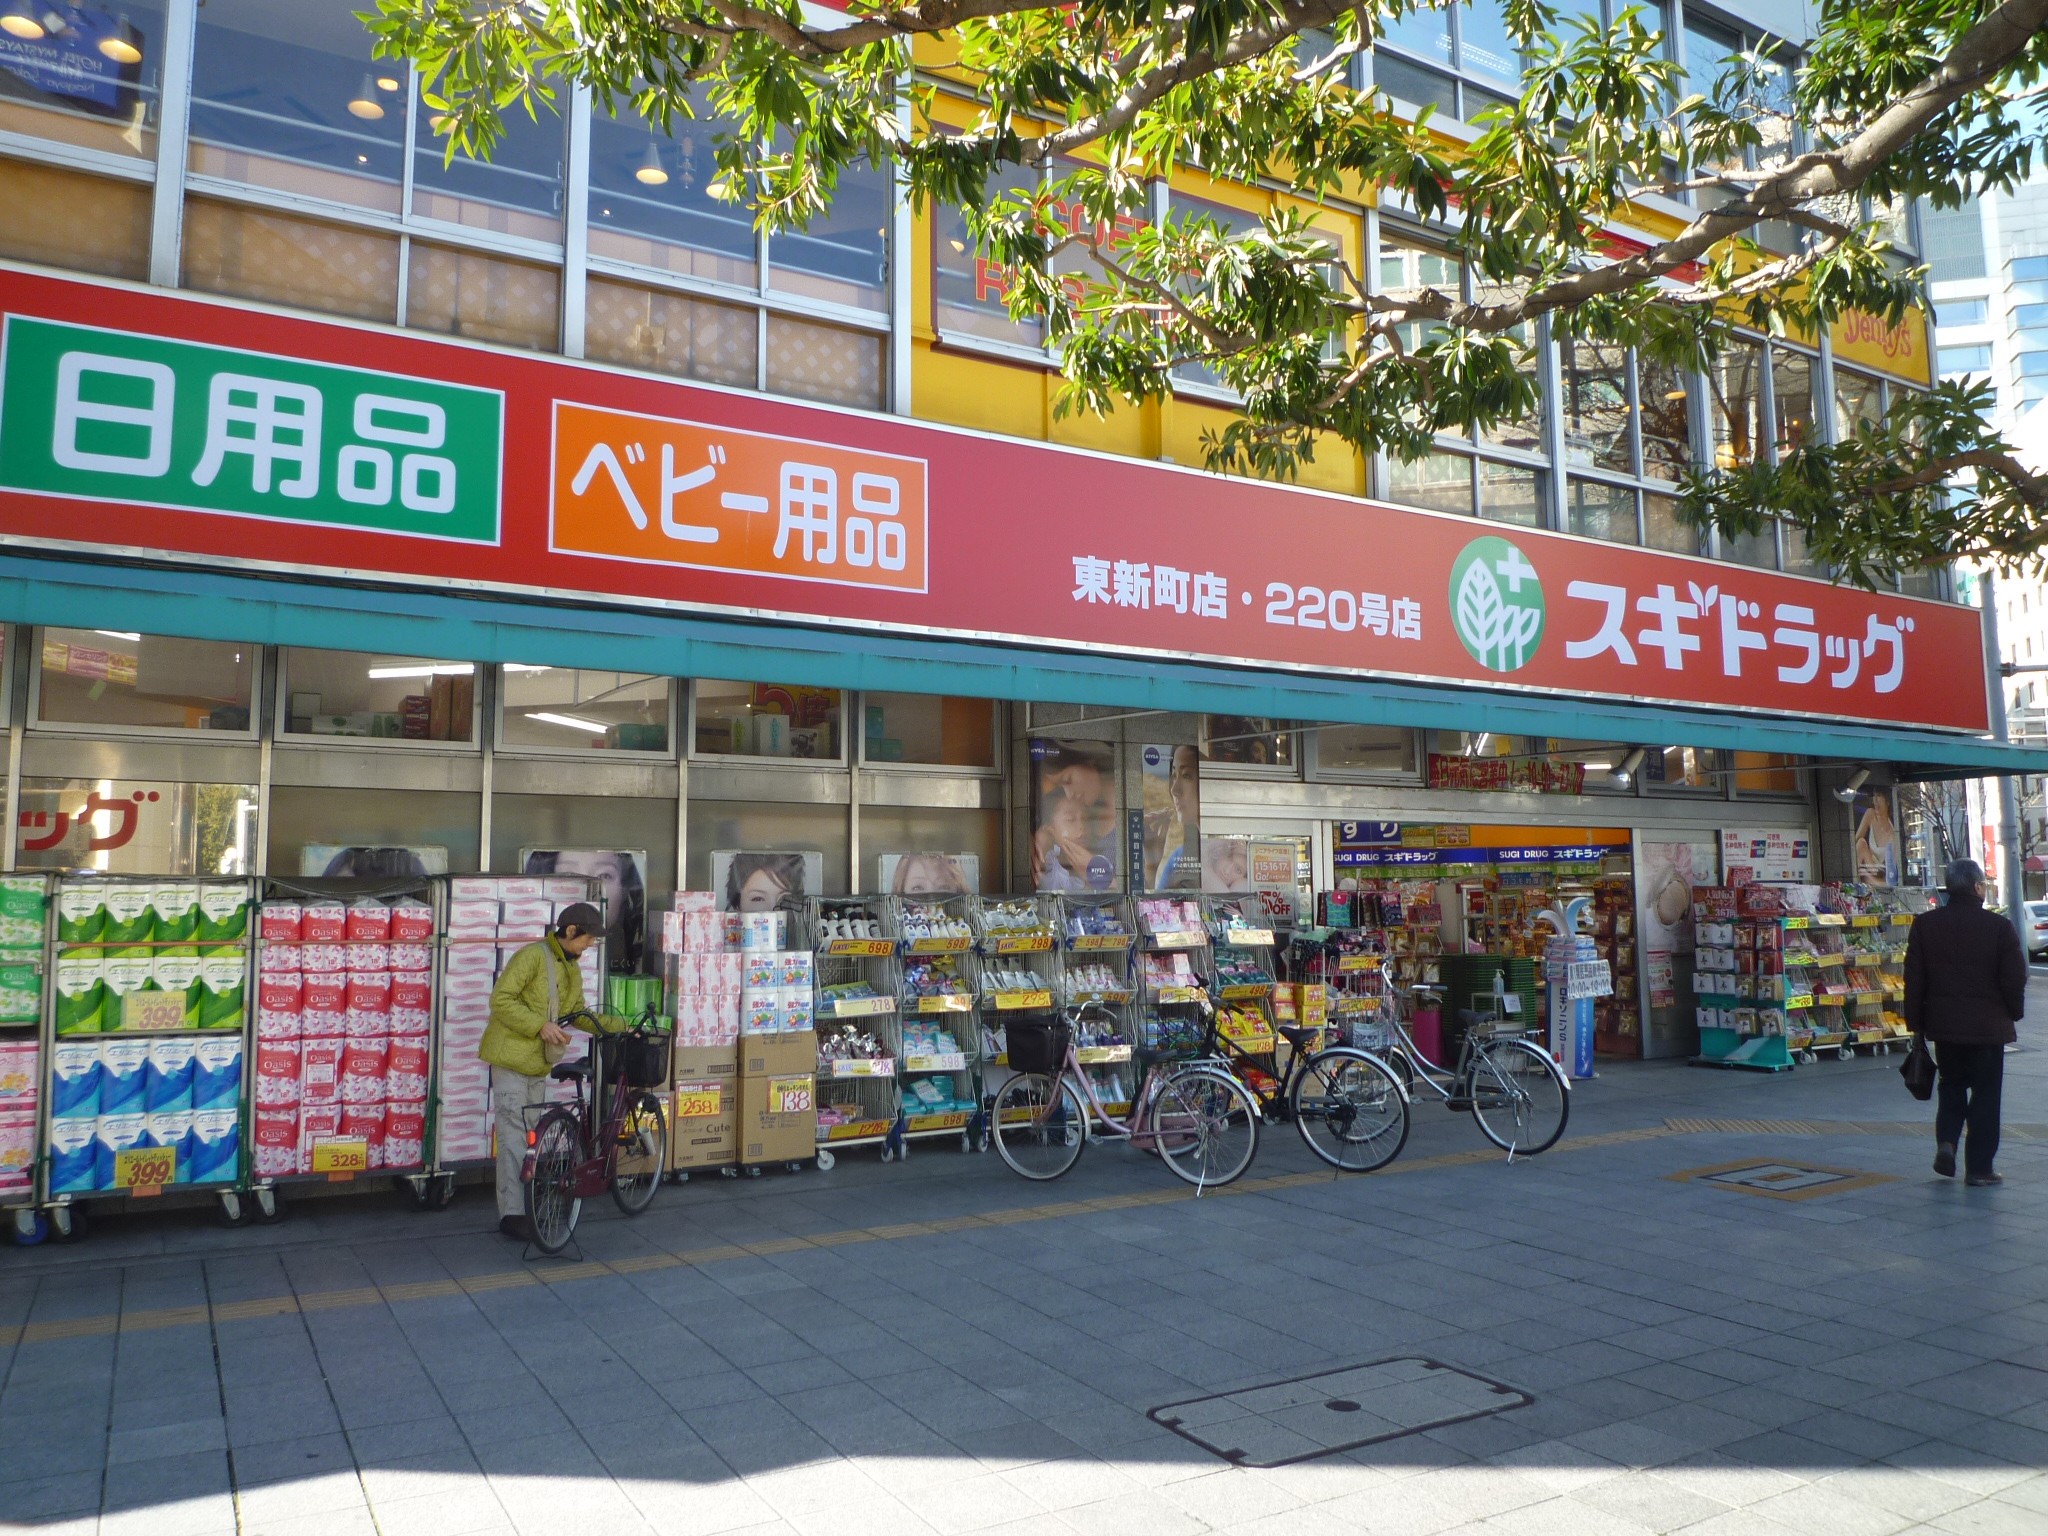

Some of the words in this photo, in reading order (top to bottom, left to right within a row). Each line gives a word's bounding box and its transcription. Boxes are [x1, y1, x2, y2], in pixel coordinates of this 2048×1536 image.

[52, 351, 456, 514] 日用品
[571, 442, 906, 571] ベビー用品
[1565, 580, 1915, 693] スギドラッグ
[1356, 853, 1380, 861] DRUG
[1385, 851, 1439, 862] スギドラッグ
[1499, 850, 1520, 859] SUGI
[1524, 850, 1549, 858] DRUG
[1273, 905, 1290, 915] OFF
[264, 928, 292, 937] Oasis
[312, 928, 339, 936] Oasis
[356, 927, 384, 936] Oasis
[400, 927, 426, 936] Oasis
[946, 939, 966, 949] 598
[1031, 938, 1049, 949] 298
[1085, 938, 1099, 947] 598
[1112, 937, 1126, 946] 798
[868, 942, 889, 954] 698
[1249, 986, 1265, 995] 498
[266, 994, 293, 1003] Oasis
[310, 994, 338, 1003] Oasis
[355, 994, 382, 1003] Oasis
[397, 992, 423, 1001] Oasis
[1106, 993, 1126, 1002] 598
[871, 999, 891, 1012] 278
[264, 1060, 292, 1069] Oasis
[352, 1059, 379, 1068] Oasis
[395, 1056, 421, 1065] Oasis
[941, 1056, 960, 1068] 598
[781, 1091, 811, 1112] 138
[309, 1120, 331, 1128] Oasis
[943, 1115, 962, 1126] 698
[349, 1126, 376, 1135] Oasis
[392, 1122, 419, 1132] Oasis
[706, 1123, 731, 1134] Cute
[260, 1129, 288, 1138] Oasis
